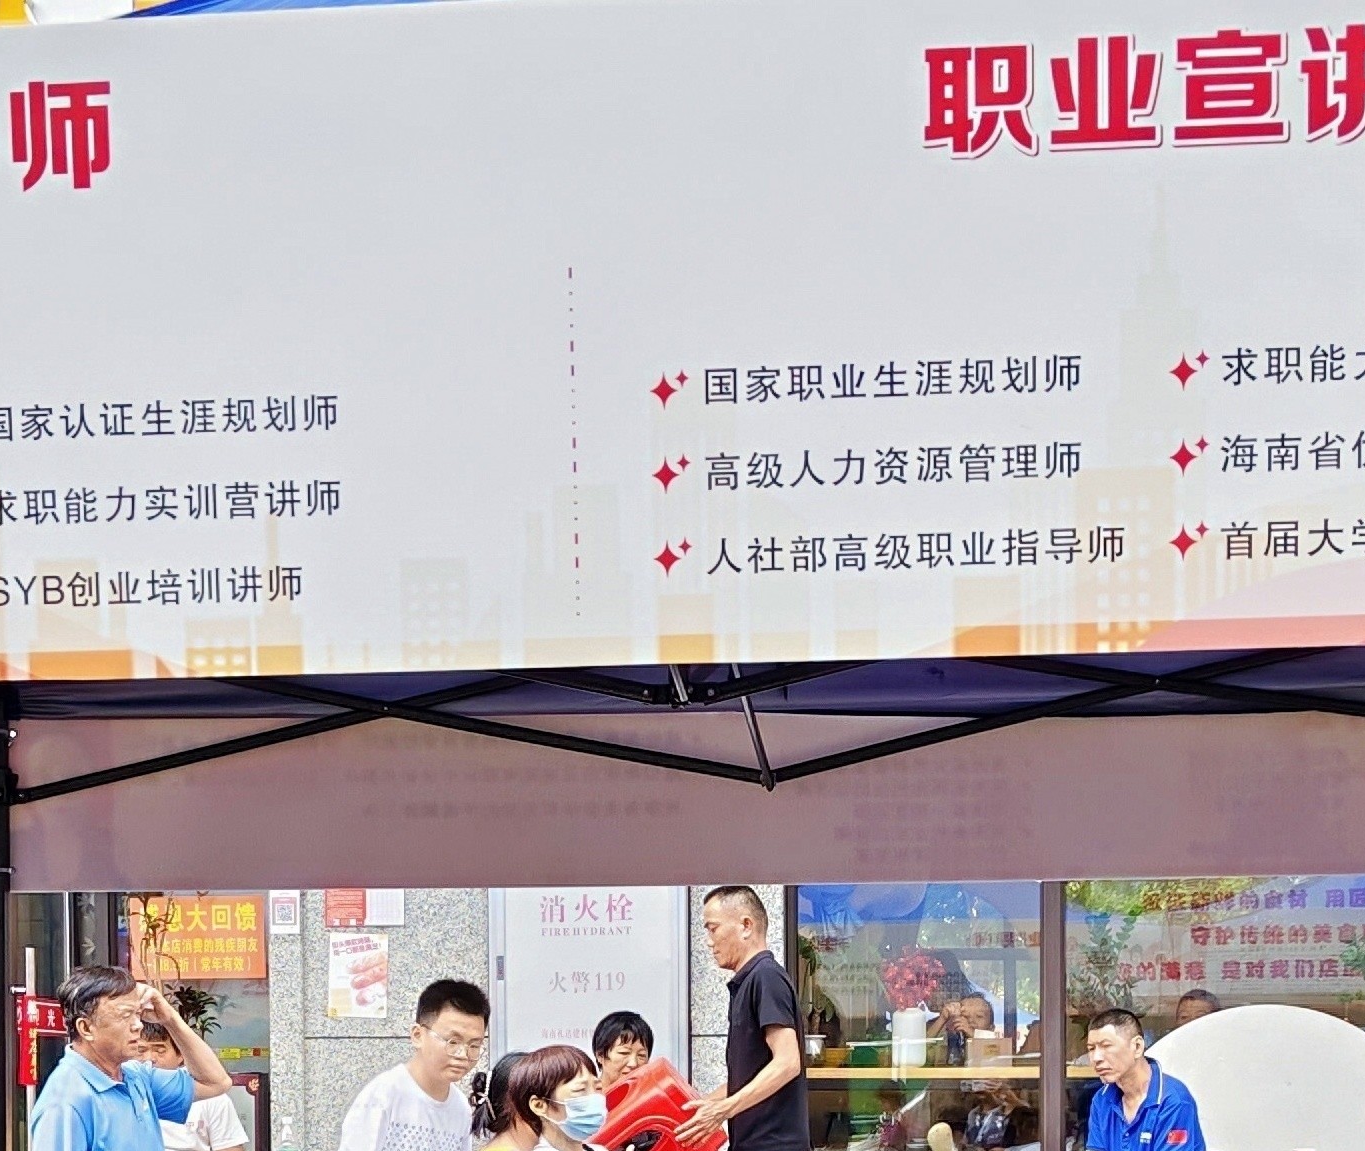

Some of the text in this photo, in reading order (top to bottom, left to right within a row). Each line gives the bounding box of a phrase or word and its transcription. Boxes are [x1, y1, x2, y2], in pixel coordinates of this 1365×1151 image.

[705, 354, 1081, 405] 国家职业生涯规划师
[705, 441, 1081, 491] 高级人力资源管理师
[707, 526, 1125, 575] 人社部高级职业指导师
[539, 893, 634, 923] 消火栓
[541, 926, 570, 937] FIRE
